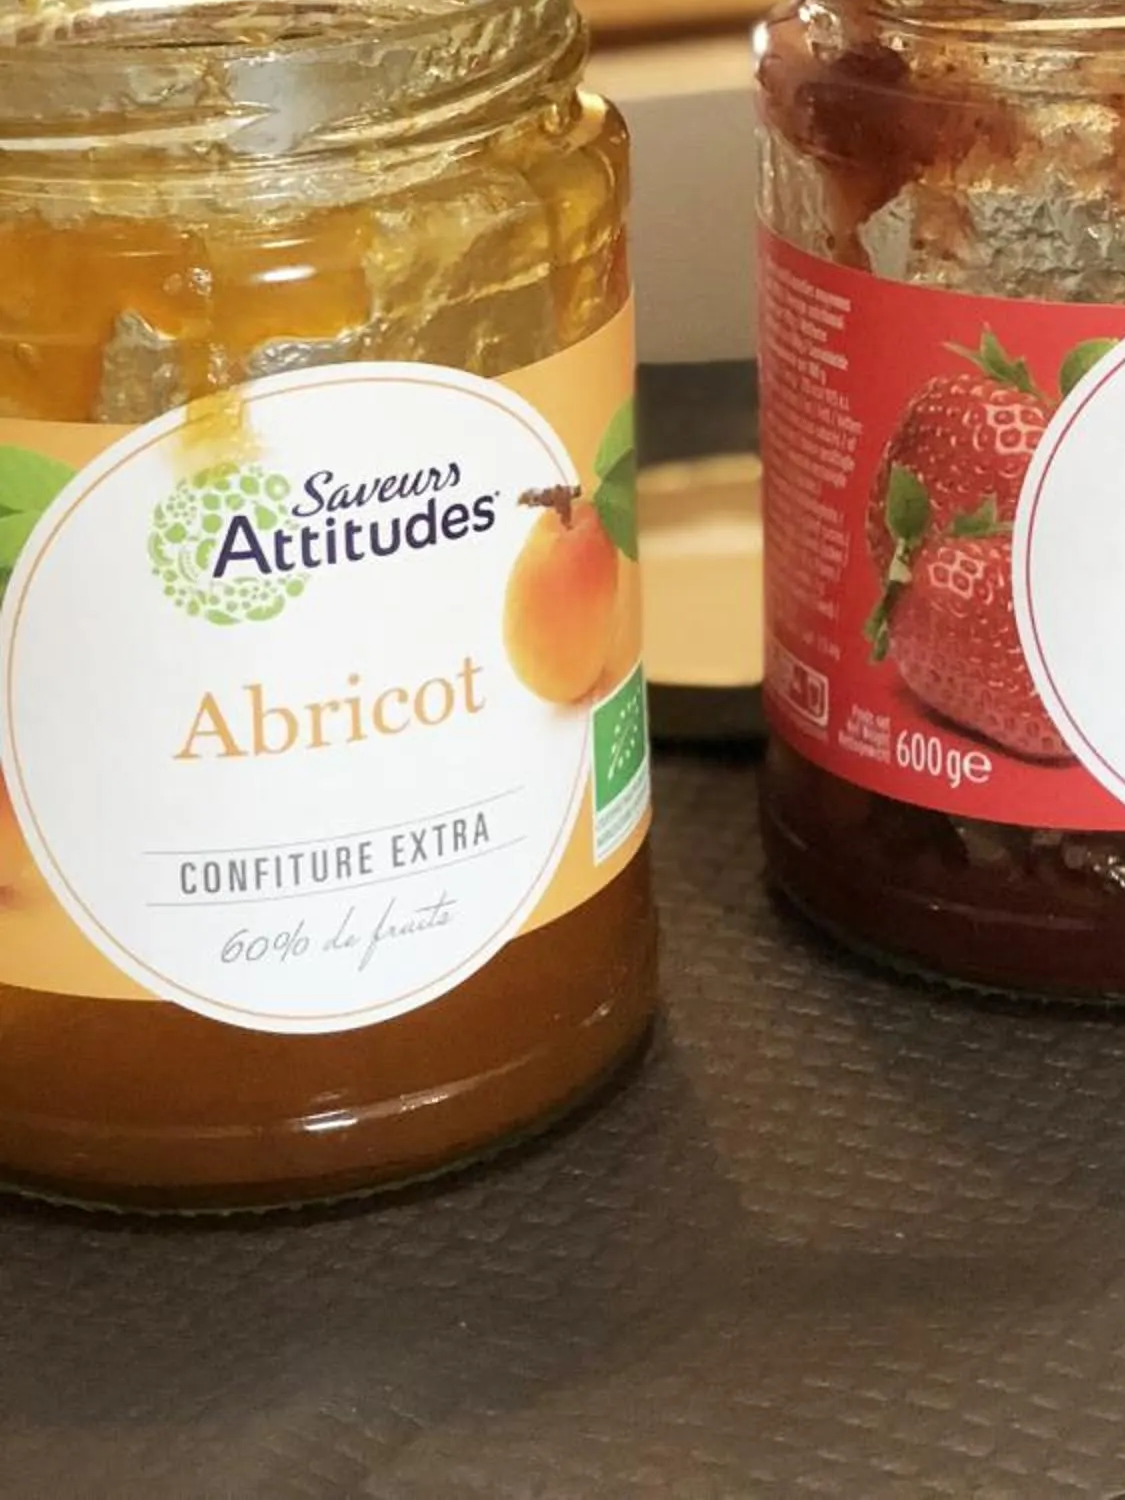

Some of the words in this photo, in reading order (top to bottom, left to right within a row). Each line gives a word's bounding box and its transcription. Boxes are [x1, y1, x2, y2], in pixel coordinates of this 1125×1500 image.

[291, 462, 461, 518] Saveurs
[213, 494, 496, 578] Attitudes
[173, 656, 486, 760] Abricot
[180, 840, 373, 895] CONFITURE
[392, 812, 490, 867] EXTRA
[221, 921, 310, 964] 60%
